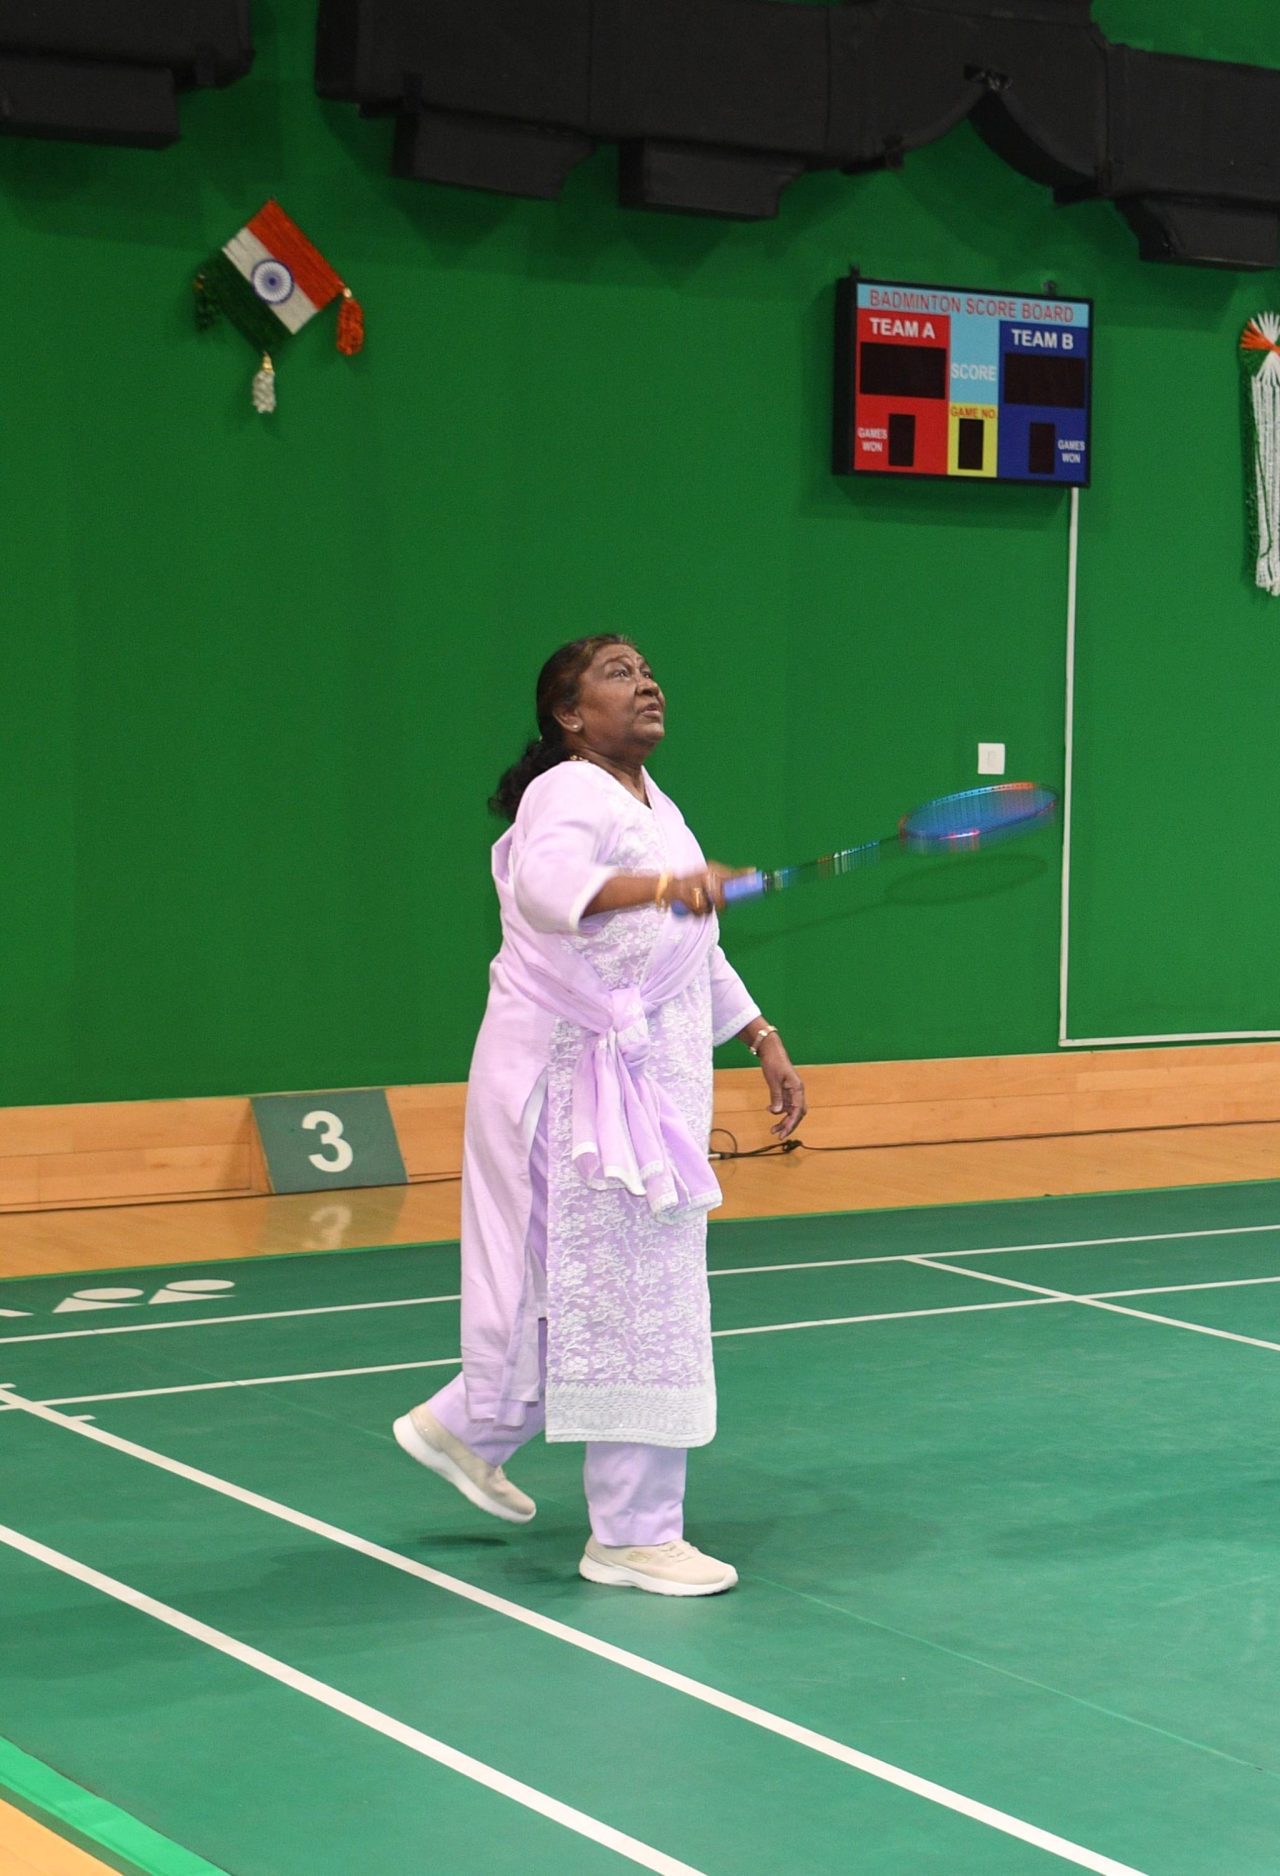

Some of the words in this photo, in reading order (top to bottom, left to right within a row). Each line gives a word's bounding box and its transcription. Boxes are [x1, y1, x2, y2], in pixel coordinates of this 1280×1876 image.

[869, 289, 961, 314] BADMINTON
[966, 298, 1017, 319] SCORE
[1022, 302, 1074, 323] BOARD
[869, 317, 919, 337] TEAM
[921, 322, 936, 339] A
[1011, 329, 1058, 348] TEAM
[1062, 333, 1074, 350] B
[950, 364, 997, 381] SCORE
[950, 405, 977, 417] GAME
[857, 427, 888, 439] GAMES
[861, 441, 883, 453] WON
[1057, 440, 1085, 451] GAMES
[1061, 453, 1081, 464] WON
[302, 1110, 354, 1173] 3
